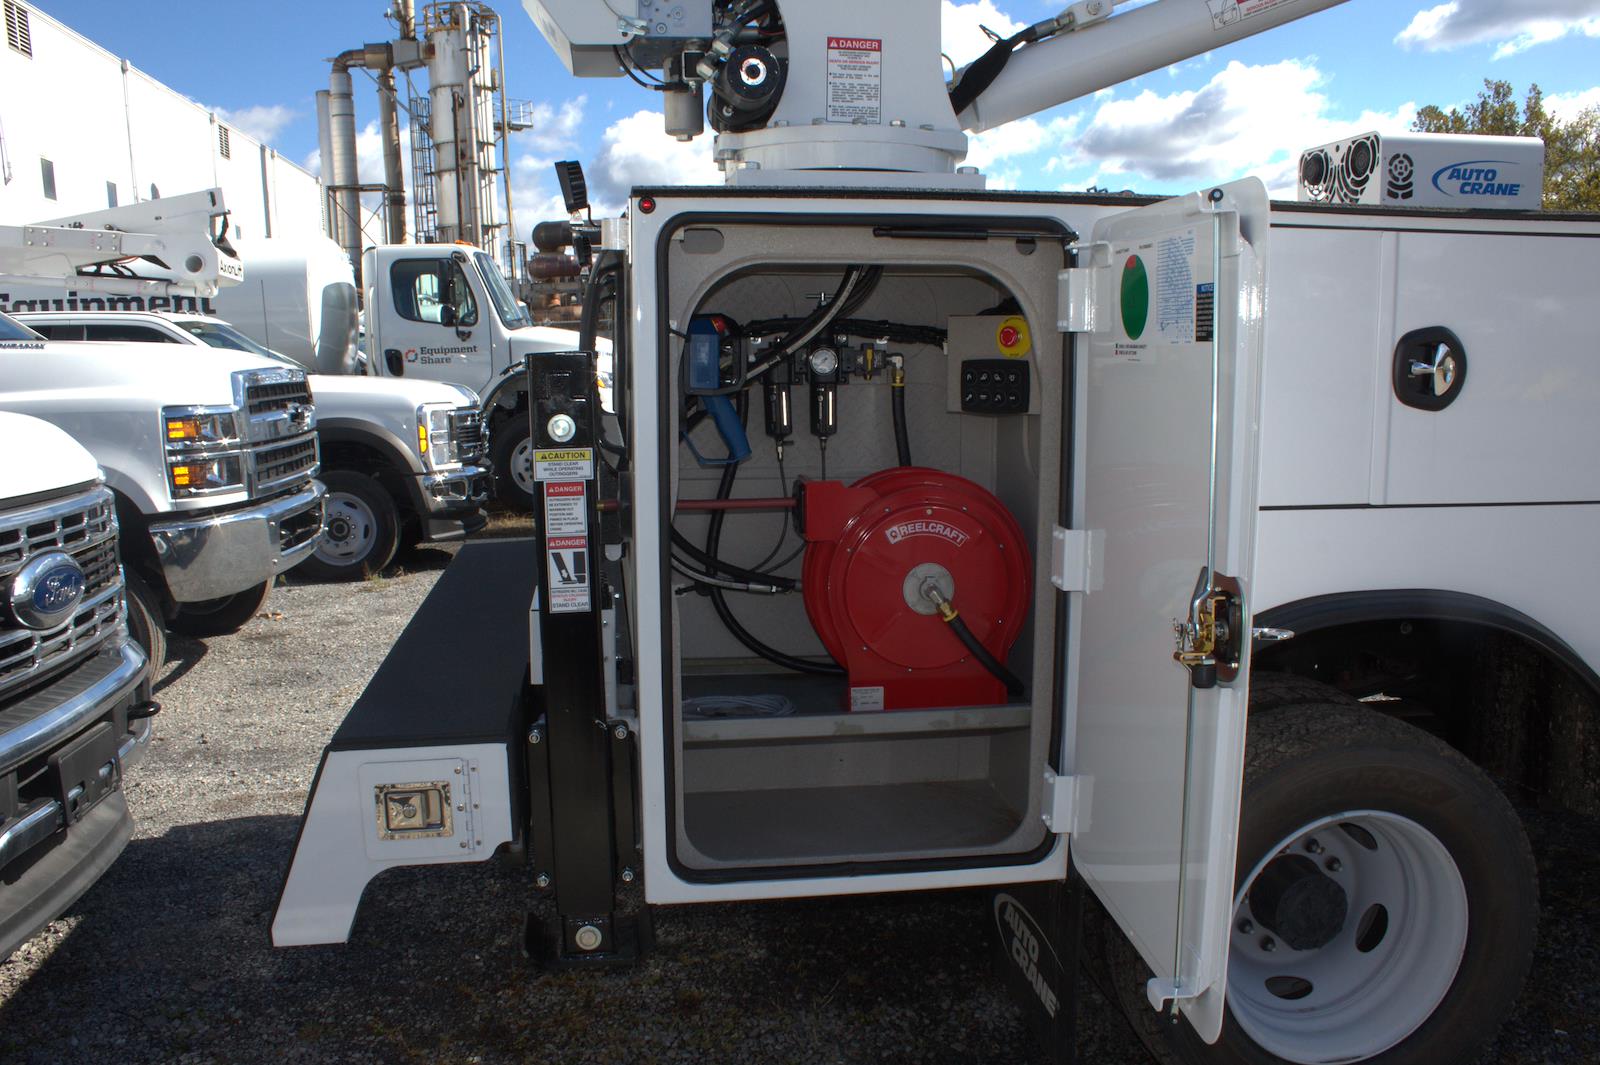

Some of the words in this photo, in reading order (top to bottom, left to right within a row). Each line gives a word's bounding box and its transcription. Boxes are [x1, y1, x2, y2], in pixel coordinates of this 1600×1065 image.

[839, 40, 879, 49] DANGER
[1447, 168, 1497, 182] AUTO
[1459, 182, 1521, 196] CRANE
[420, 345, 478, 356] Equipment
[420, 356, 452, 365] Share
[548, 452, 585, 460] CAUTION
[899, 522, 966, 543] REELCRAFT
[1004, 902, 1039, 963] AUTO
[1012, 936, 1057, 1020] CRANE
